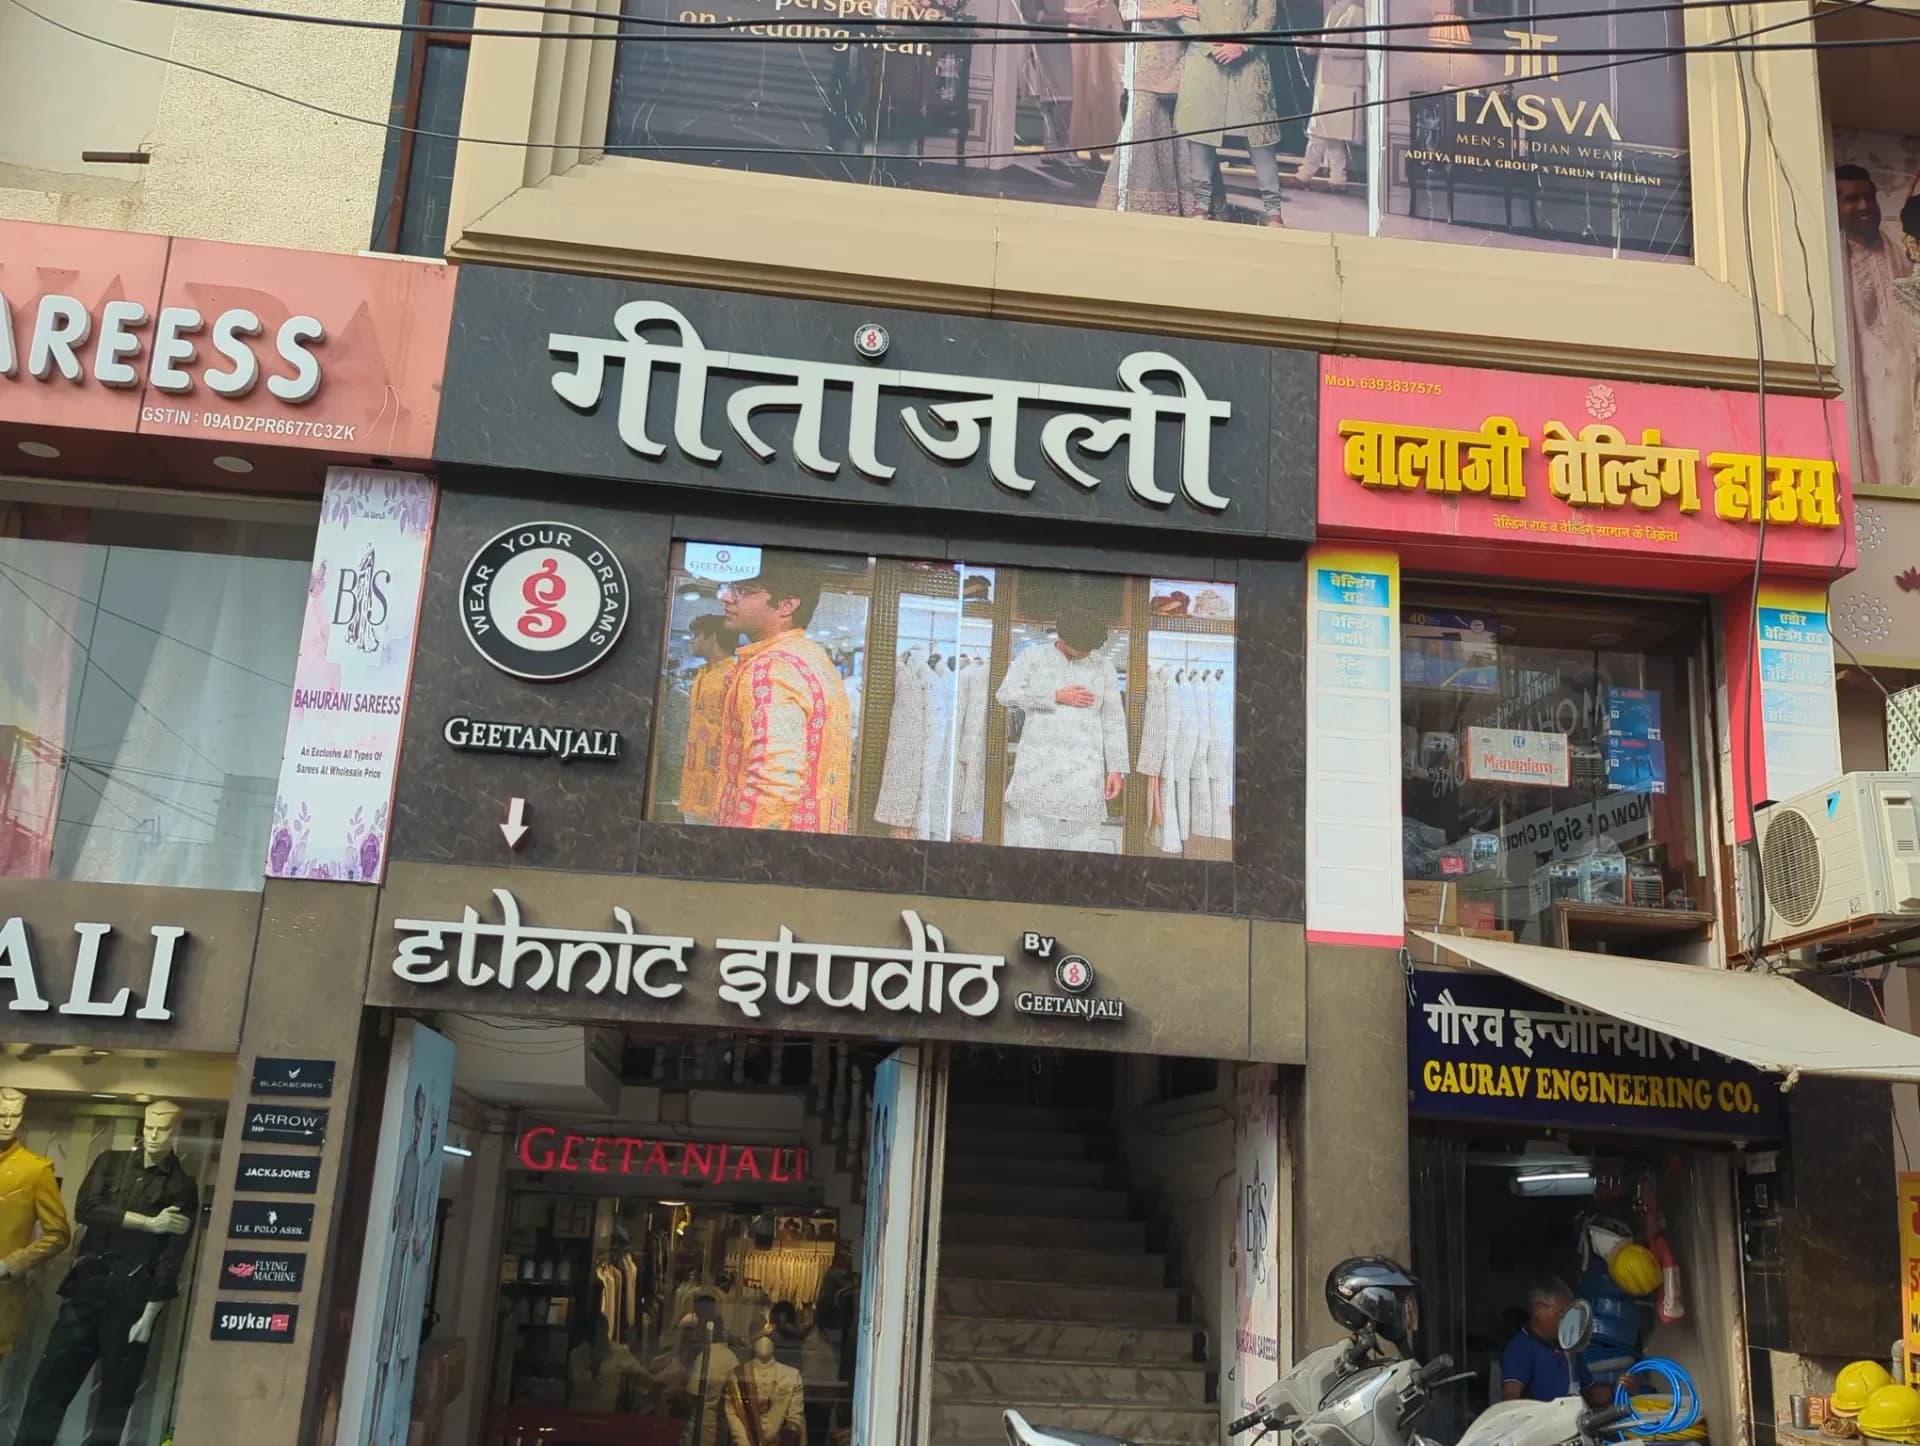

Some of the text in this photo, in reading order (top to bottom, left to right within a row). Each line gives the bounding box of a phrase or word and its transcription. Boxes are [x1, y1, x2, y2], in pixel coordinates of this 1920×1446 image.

[679, 10, 716, 24] on
[1443, 84, 1622, 141] TASVA
[1456, 133, 1623, 162] MEN'S INDIAN WEAR
[1405, 149, 1450, 163] ADITYA
[1455, 154, 1491, 168] BIRLA
[1495, 159, 1539, 172] GROUP
[1553, 165, 1594, 179] TARUN
[141, 407, 191, 425] GSTIN
[203, 412, 356, 441] 09ADZPR6677C3ZK
[1338, 416, 1840, 528] बालाजी वेल्डिंग हाउस
[470, 530, 620, 646] WEAR YOUR DREAMS
[294, 689, 402, 715] BAHURANI SAREESS
[444, 717, 619, 758] GEETANJALI
[301, 746, 383, 762] An Exclusive All Types Of
[1484, 753, 1553, 774] Mangalam
[296, 763, 381, 779] Sarees At Wholesale Price
[392, 888, 1006, 1018] ethnic studio
[1025, 933, 1054, 957] By
[1018, 992, 1123, 1018] GEETANJALI
[1423, 988, 1505, 1048] गौरव
[260, 1080, 323, 1090] BLACKBERRYS
[1424, 1060, 1760, 1114] GAURAV ENGINEERING CO.
[252, 1113, 318, 1127] ARROW
[518, 1126, 805, 1185] GEETANJALI
[244, 1167, 311, 1179] JACK&JONES
[235, 1224, 304, 1235] U.S. POLO ASSN.
[252, 1271, 297, 1282] MACHINE
[254, 1260, 288, 1272] FLYING
[220, 1312, 273, 1330] spykar
